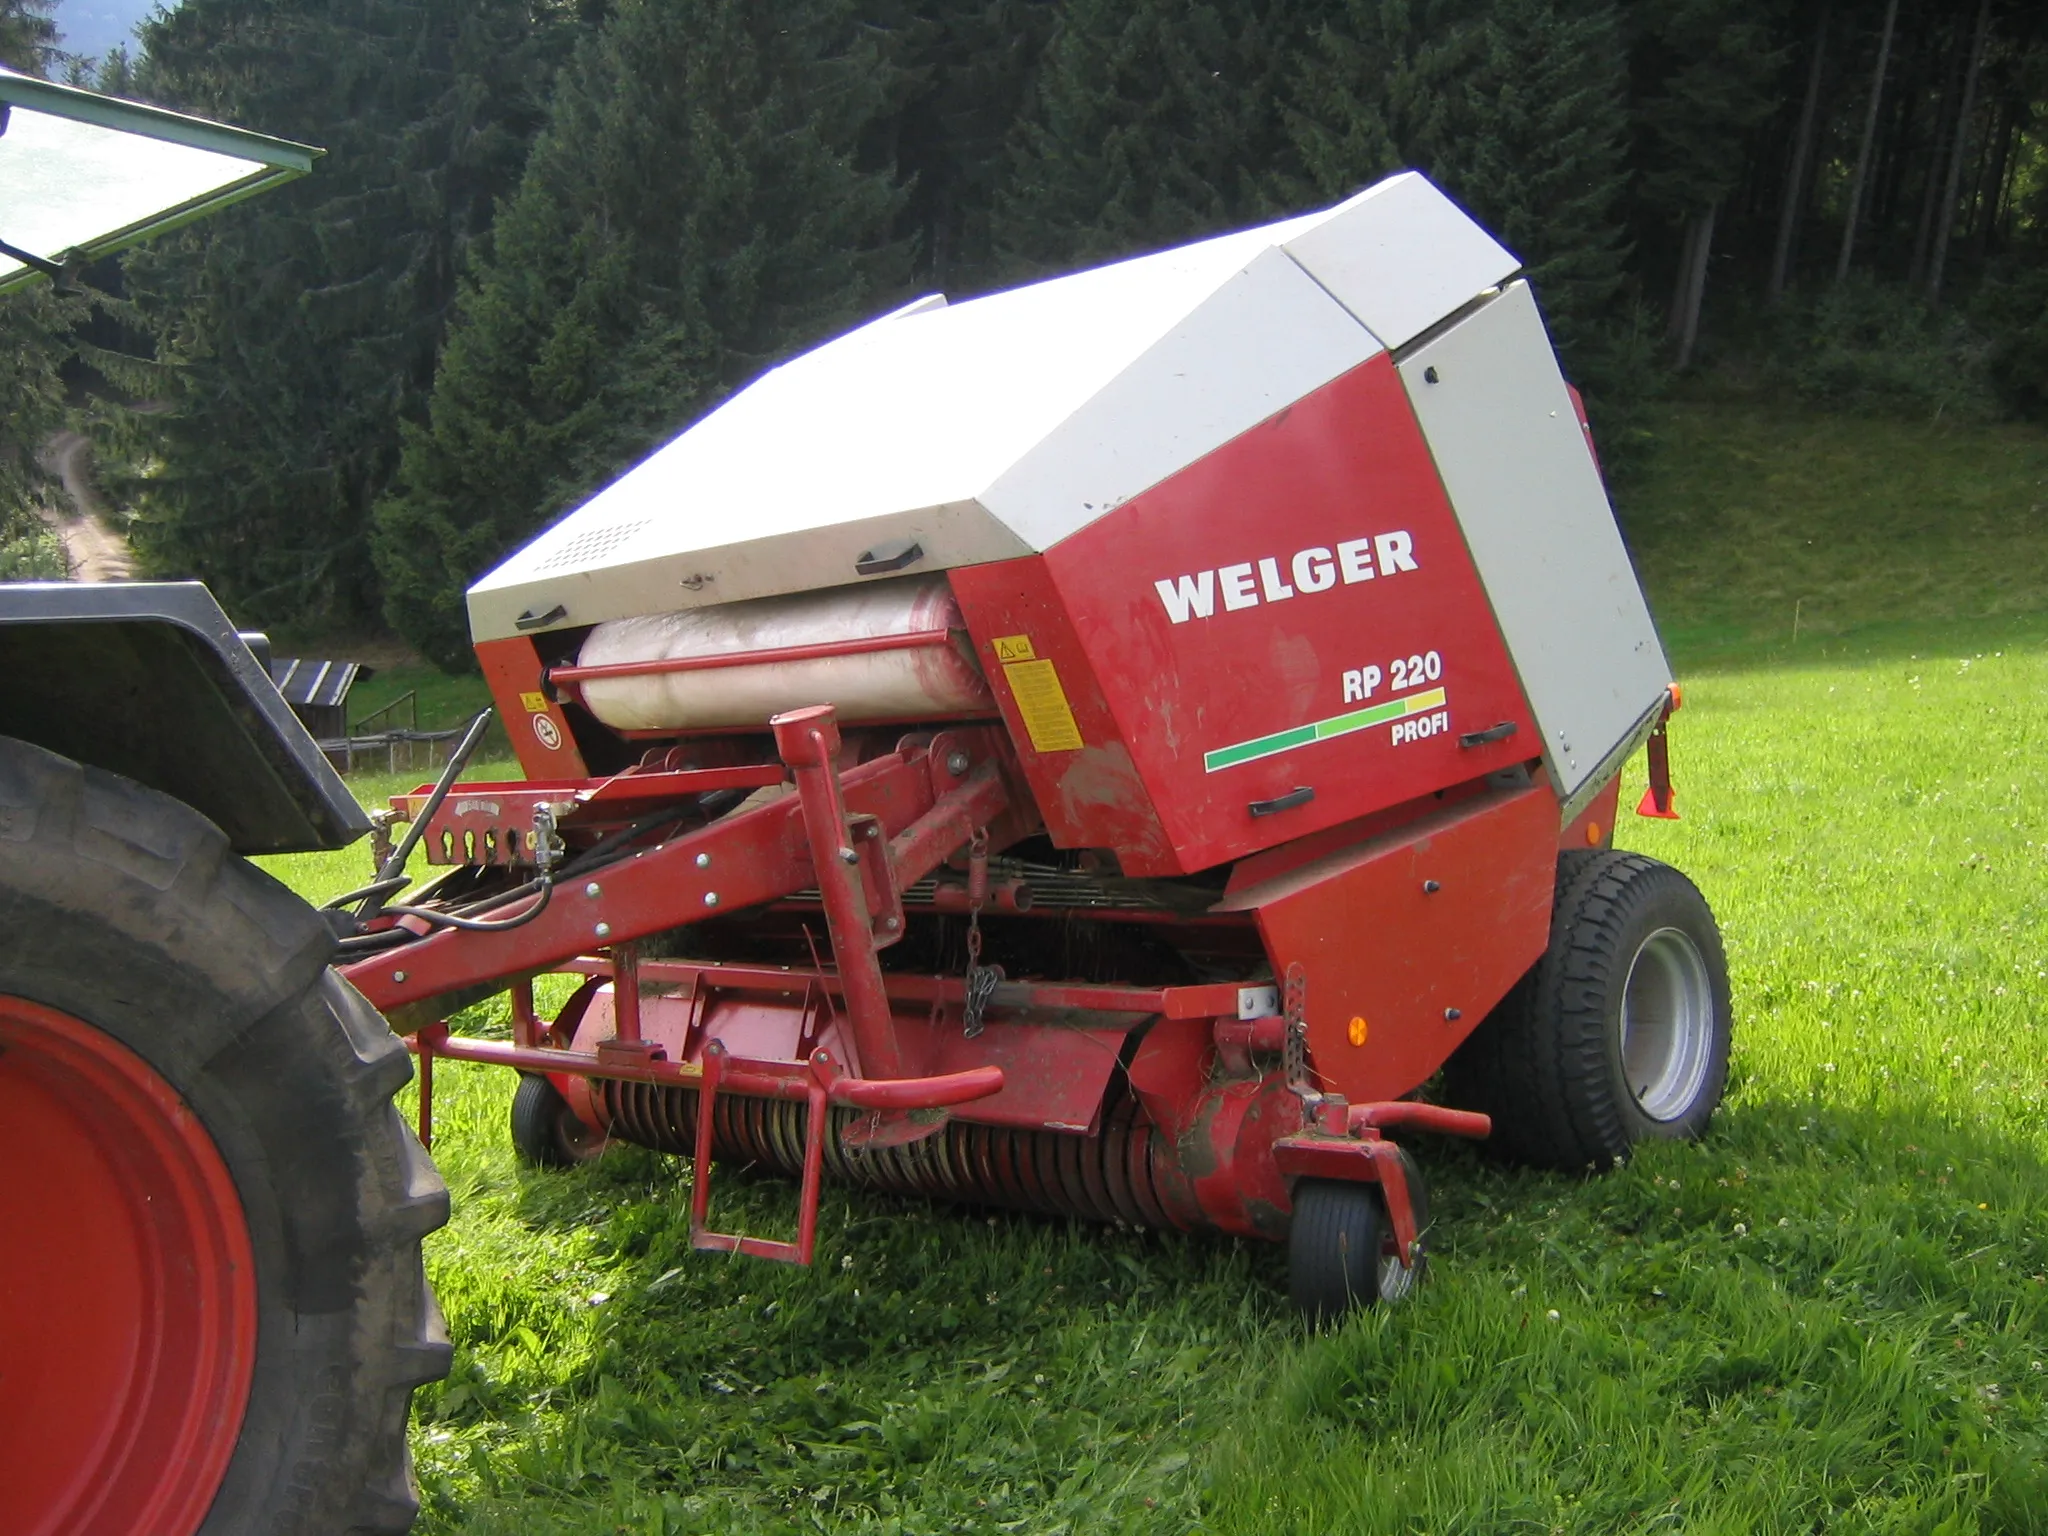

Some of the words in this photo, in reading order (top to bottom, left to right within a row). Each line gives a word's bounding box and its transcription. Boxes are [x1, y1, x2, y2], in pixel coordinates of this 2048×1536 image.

[1155, 530, 1418, 625] WELGER
[1342, 664, 1382, 704] RP
[1390, 650, 1442, 691] 220
[1391, 711, 1449, 747] PROFI
